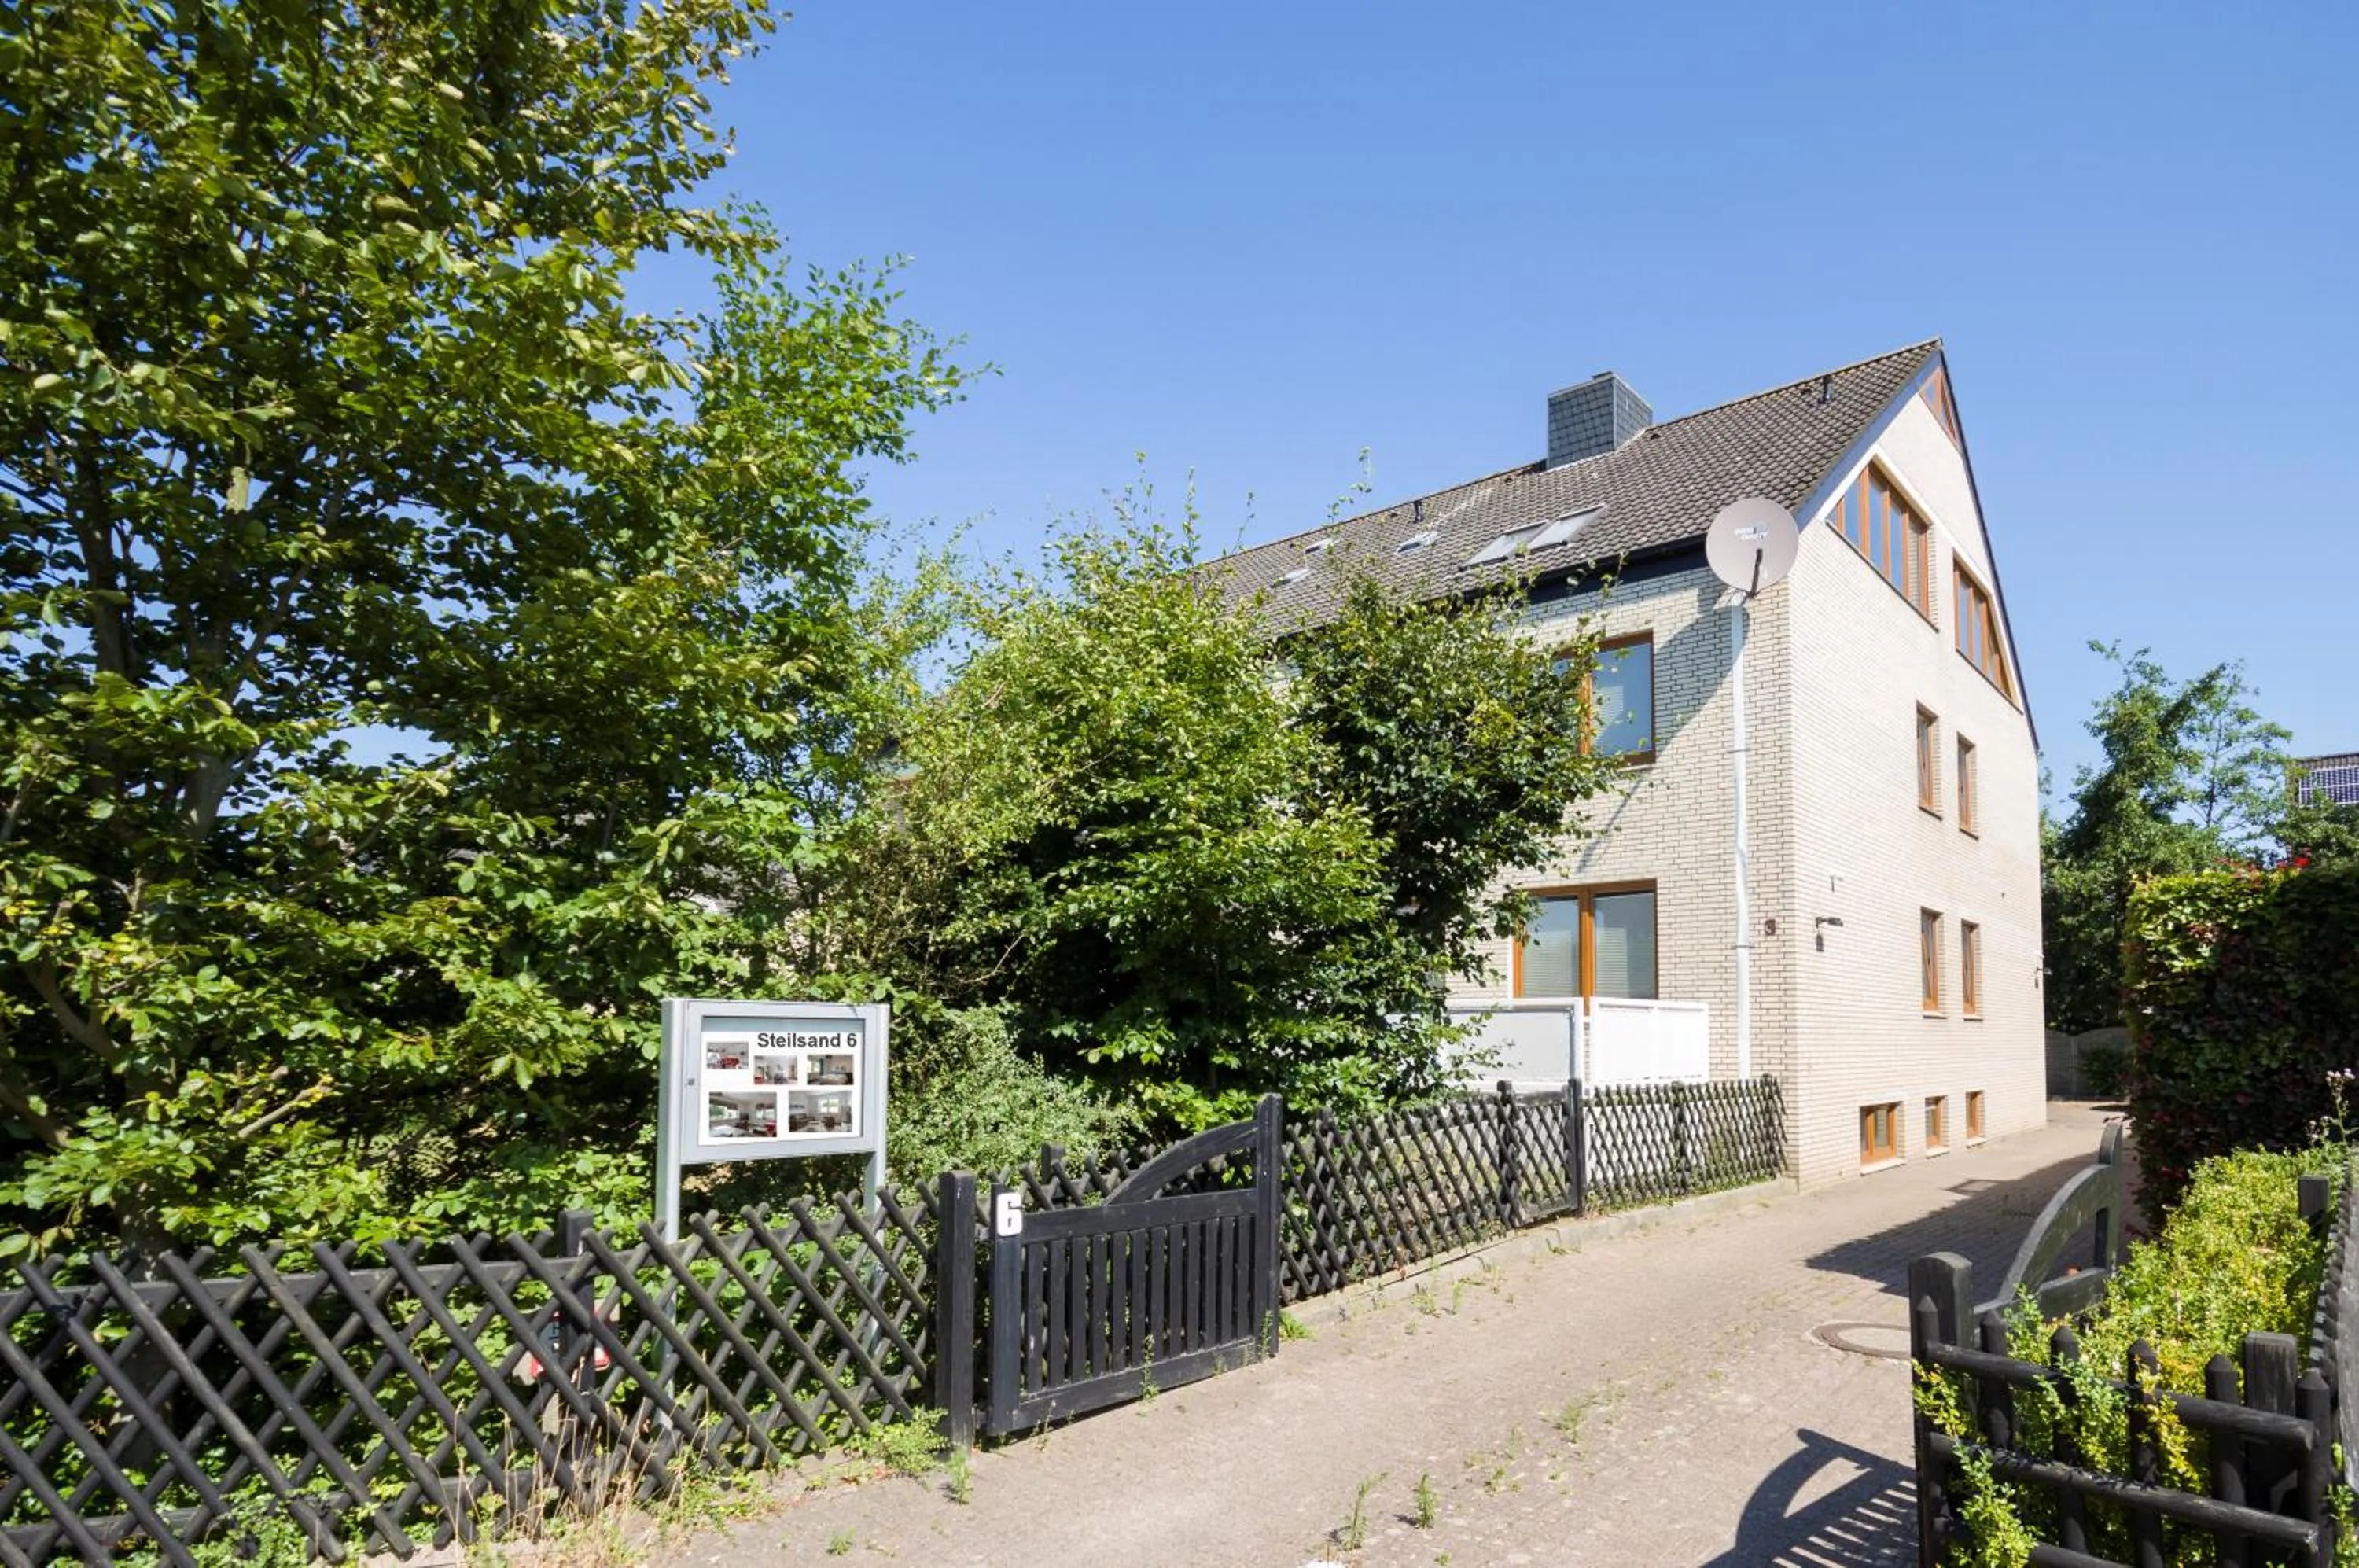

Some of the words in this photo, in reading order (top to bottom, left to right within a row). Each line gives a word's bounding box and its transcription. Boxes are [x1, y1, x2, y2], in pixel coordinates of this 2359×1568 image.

[757, 1032, 841, 1047] Steilsand
[847, 1032, 857, 1047] 6
[996, 1193, 1021, 1237] 6
